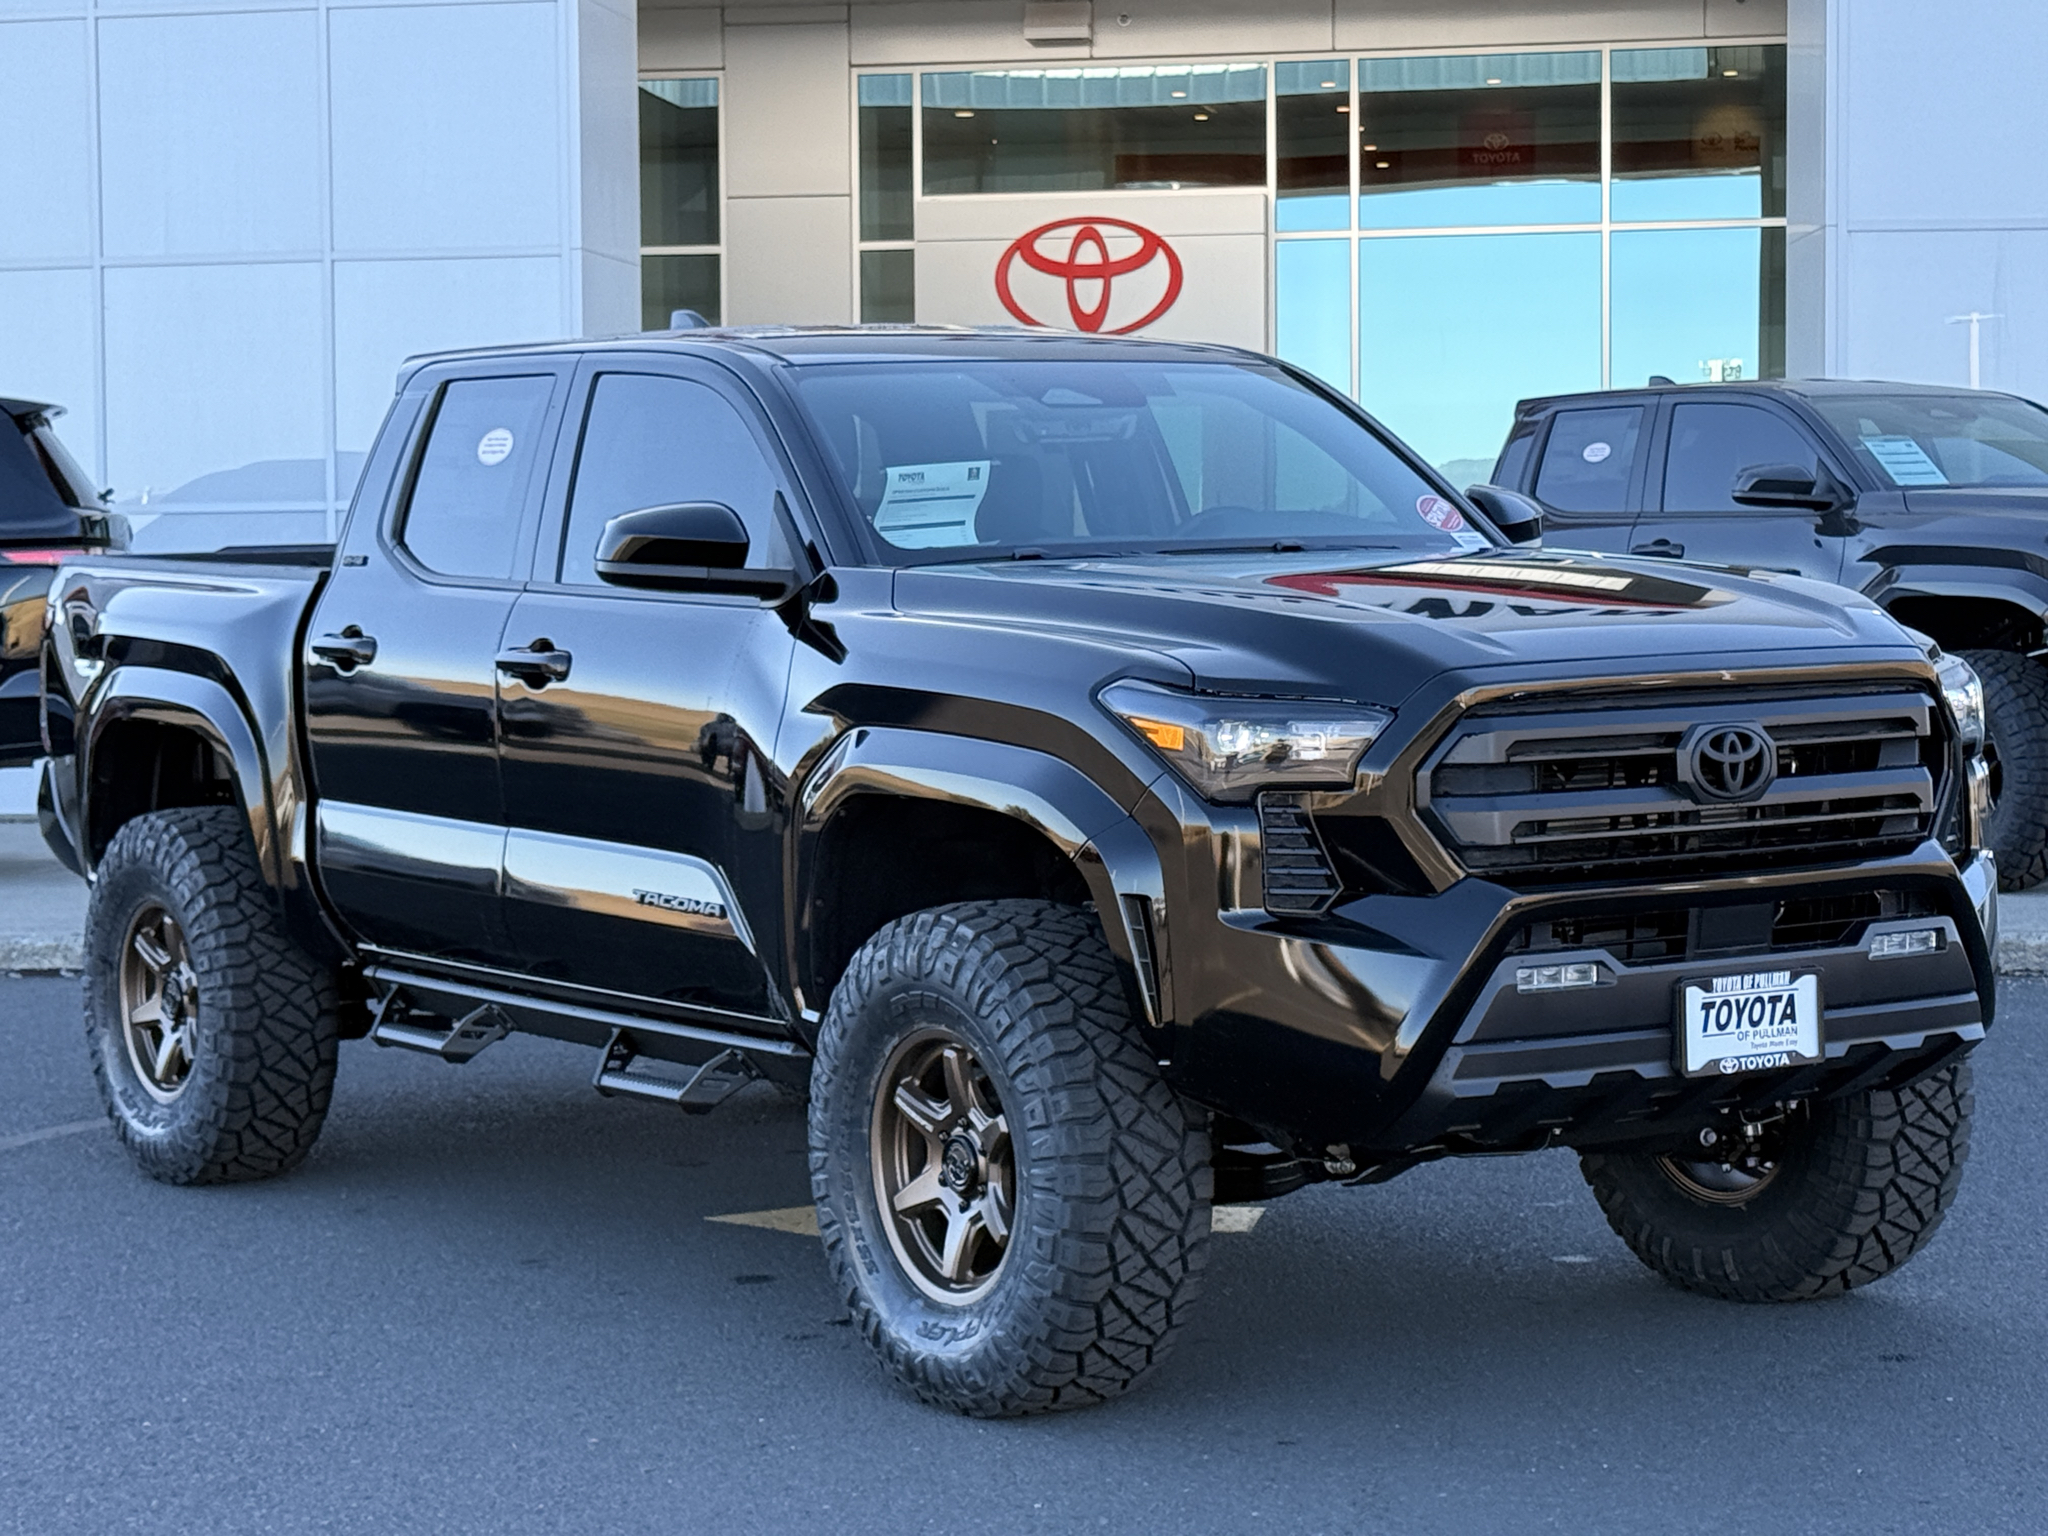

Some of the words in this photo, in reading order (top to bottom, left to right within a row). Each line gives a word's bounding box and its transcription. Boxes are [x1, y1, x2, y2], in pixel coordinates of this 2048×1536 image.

[1472, 152, 1520, 164] TOYOTA
[633, 890, 724, 917] TACOMA
[1713, 976, 1741, 993] TOYOTA
[1743, 974, 1753, 990] OF
[1701, 993, 1797, 1033] TOYOTA
[1737, 1030, 1750, 1041] OF
[1753, 1026, 1798, 1040] PULLMAN
[1740, 1053, 1790, 1070] TOYOTA
